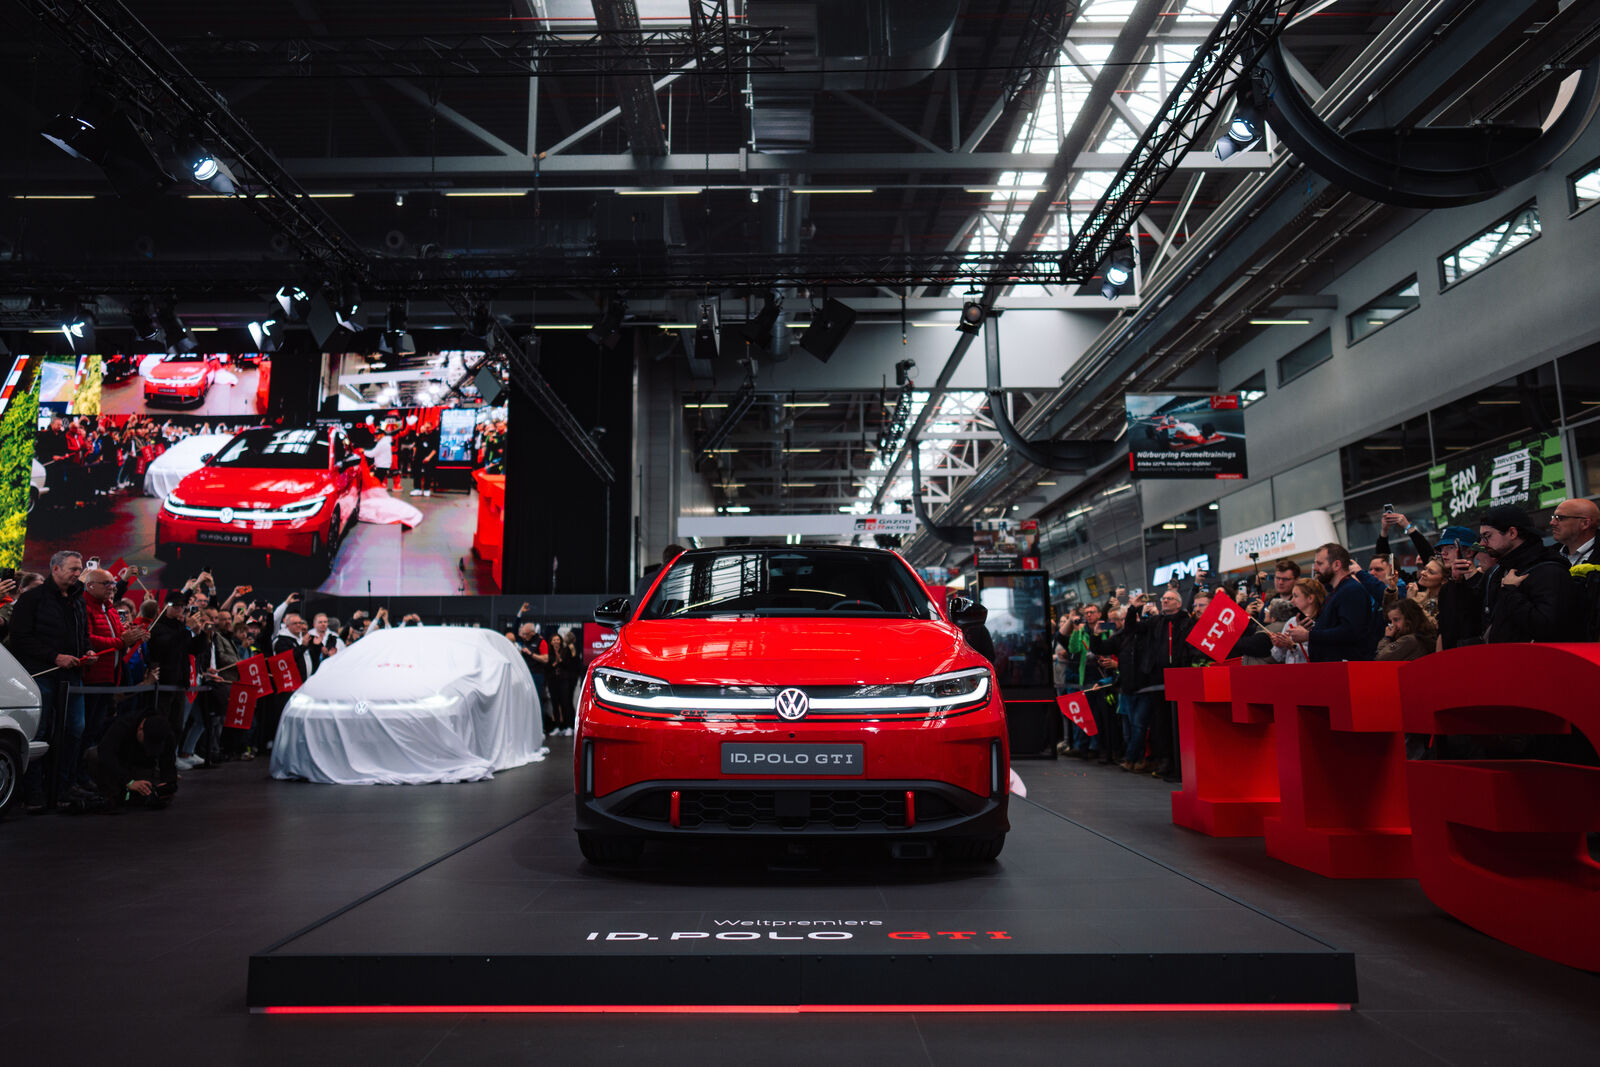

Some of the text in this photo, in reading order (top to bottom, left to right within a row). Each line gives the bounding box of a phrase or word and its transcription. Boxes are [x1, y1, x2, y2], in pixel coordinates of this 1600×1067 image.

[1137, 451, 1237, 459] Nürburgring Formeltrainings
[1450, 465, 1477, 497] FAN
[1491, 459, 1531, 498] 24
[1449, 485, 1481, 518] SHOP
[1490, 491, 1529, 508] nürburgring
[1234, 521, 1294, 556] racewear24
[1166, 554, 1209, 583] AMG
[1200, 607, 1236, 652] GTI
[277, 658, 294, 689] GTI
[234, 691, 248, 726] GTI
[815, 753, 853, 764] GTI
[714, 919, 883, 927] Weltpremiere
[887, 931, 1012, 940] GTI
